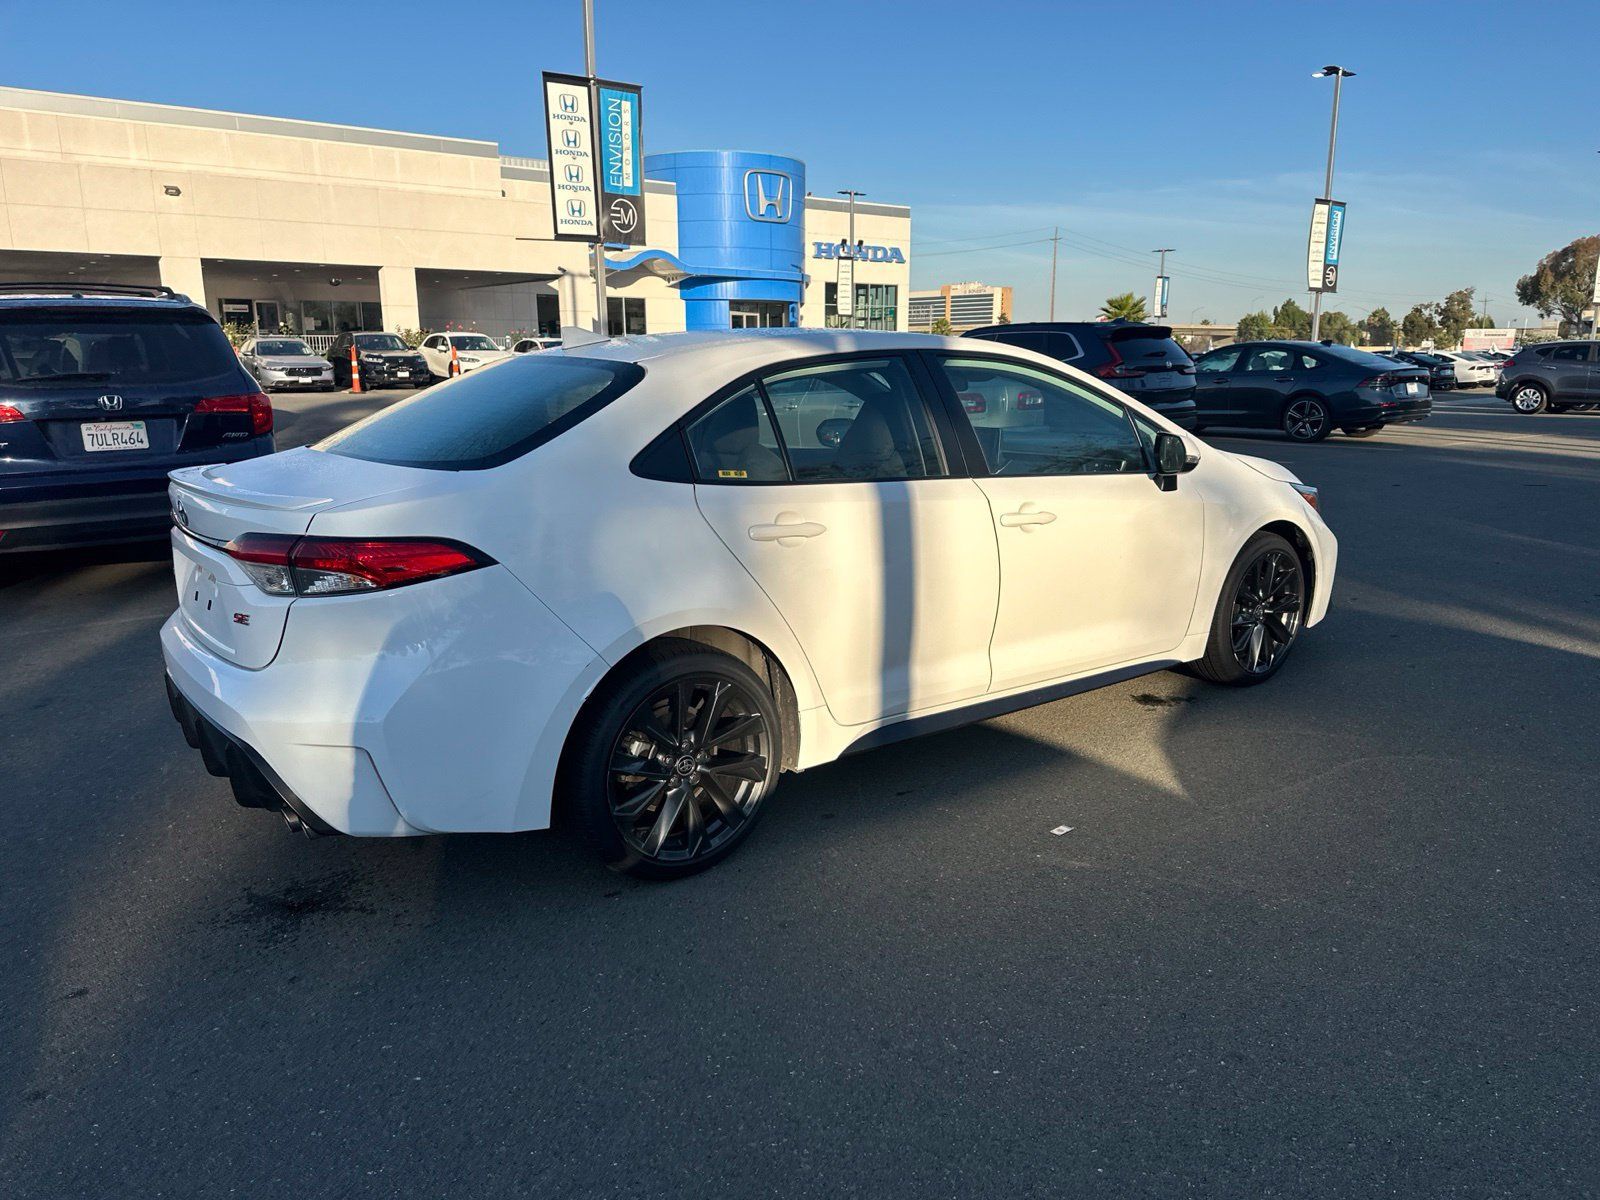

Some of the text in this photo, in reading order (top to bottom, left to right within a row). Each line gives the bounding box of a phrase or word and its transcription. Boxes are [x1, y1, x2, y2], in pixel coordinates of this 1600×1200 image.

[552, 113, 587, 123] HONDA
[608, 98, 622, 187] ENVISION
[555, 148, 589, 158] HONDA
[557, 183, 592, 192] HONDA
[560, 218, 594, 226] HONDA
[812, 242, 905, 263] HONDA
[94, 423, 131, 433] California
[87, 432, 144, 446] 7ULR464
[233, 613, 250, 625] SE
